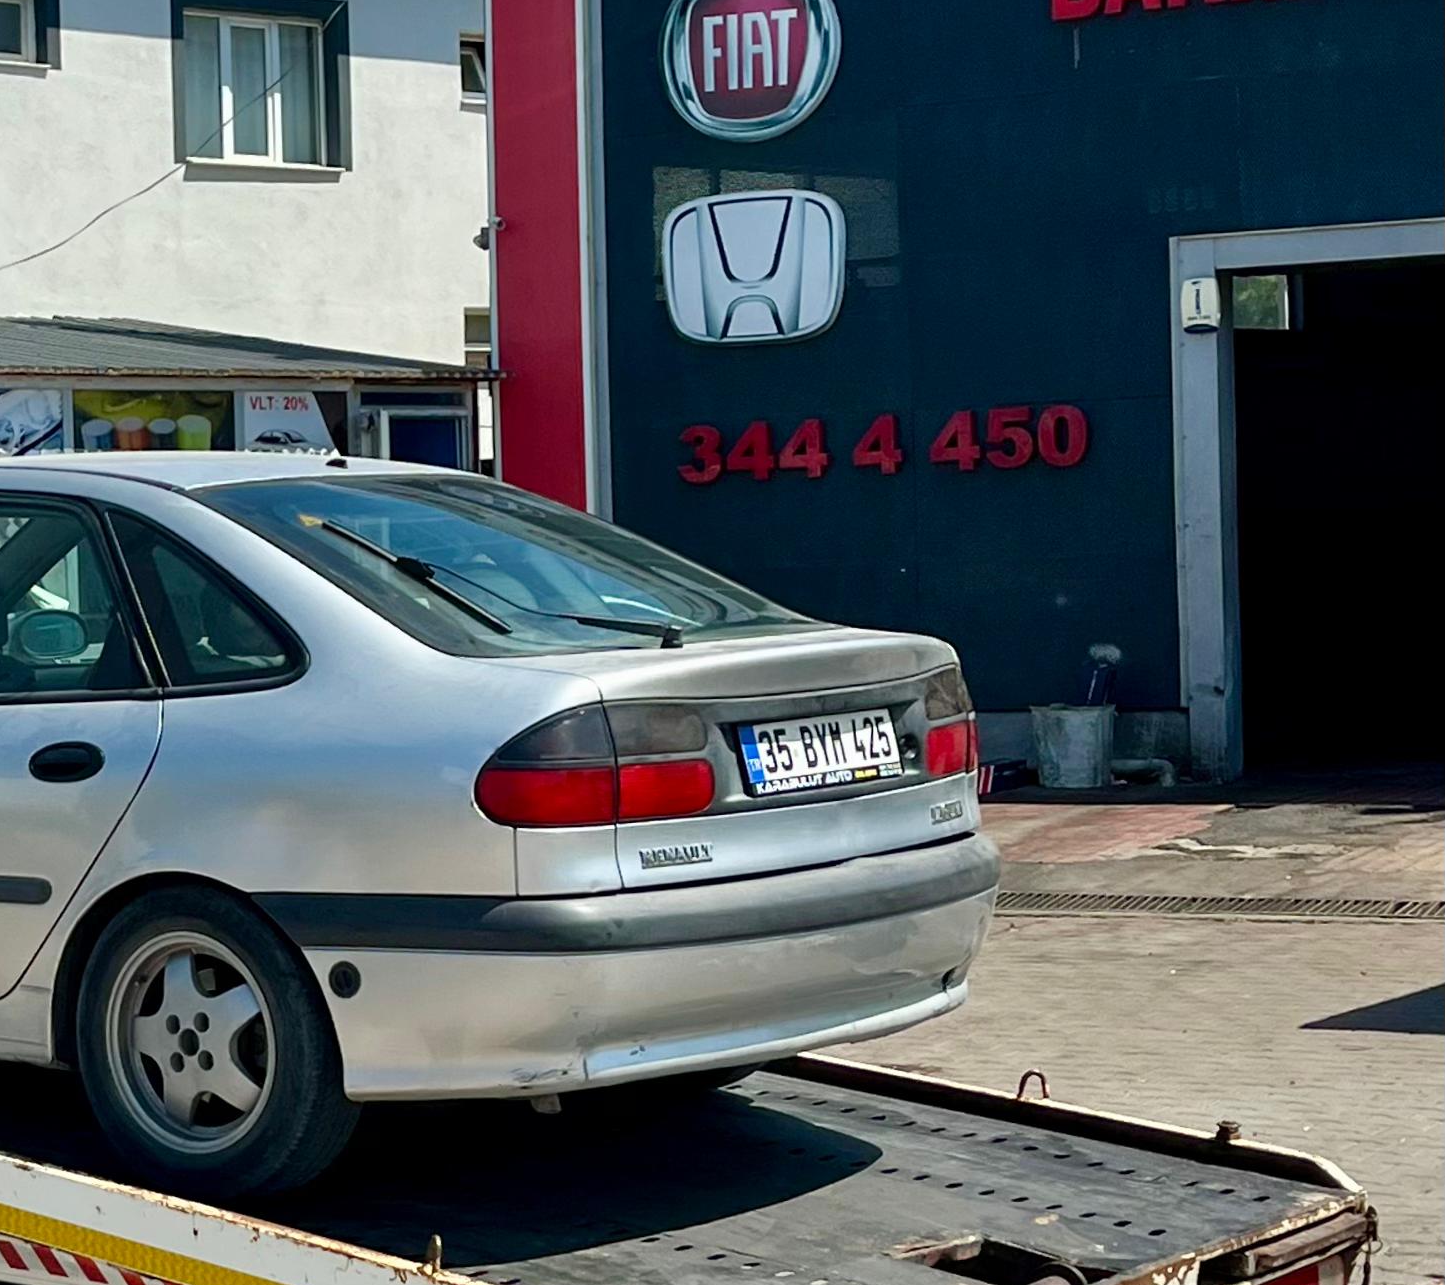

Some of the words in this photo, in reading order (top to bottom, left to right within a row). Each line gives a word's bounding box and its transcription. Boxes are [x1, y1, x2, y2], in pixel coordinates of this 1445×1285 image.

[702, 7, 799, 93] FIAT
[250, 396, 279, 412] VLT:
[283, 395, 309, 412] 20%
[678, 418, 830, 486] 344
[851, 413, 903, 475] 4
[929, 404, 1090, 473] 450
[757, 728, 795, 773] 35
[851, 715, 894, 761] 425
[748, 756, 761, 772] TR
[756, 775, 824, 795] KARABULUT
[824, 769, 853, 785] AUTO
[639, 843, 713, 869] RENAULT
